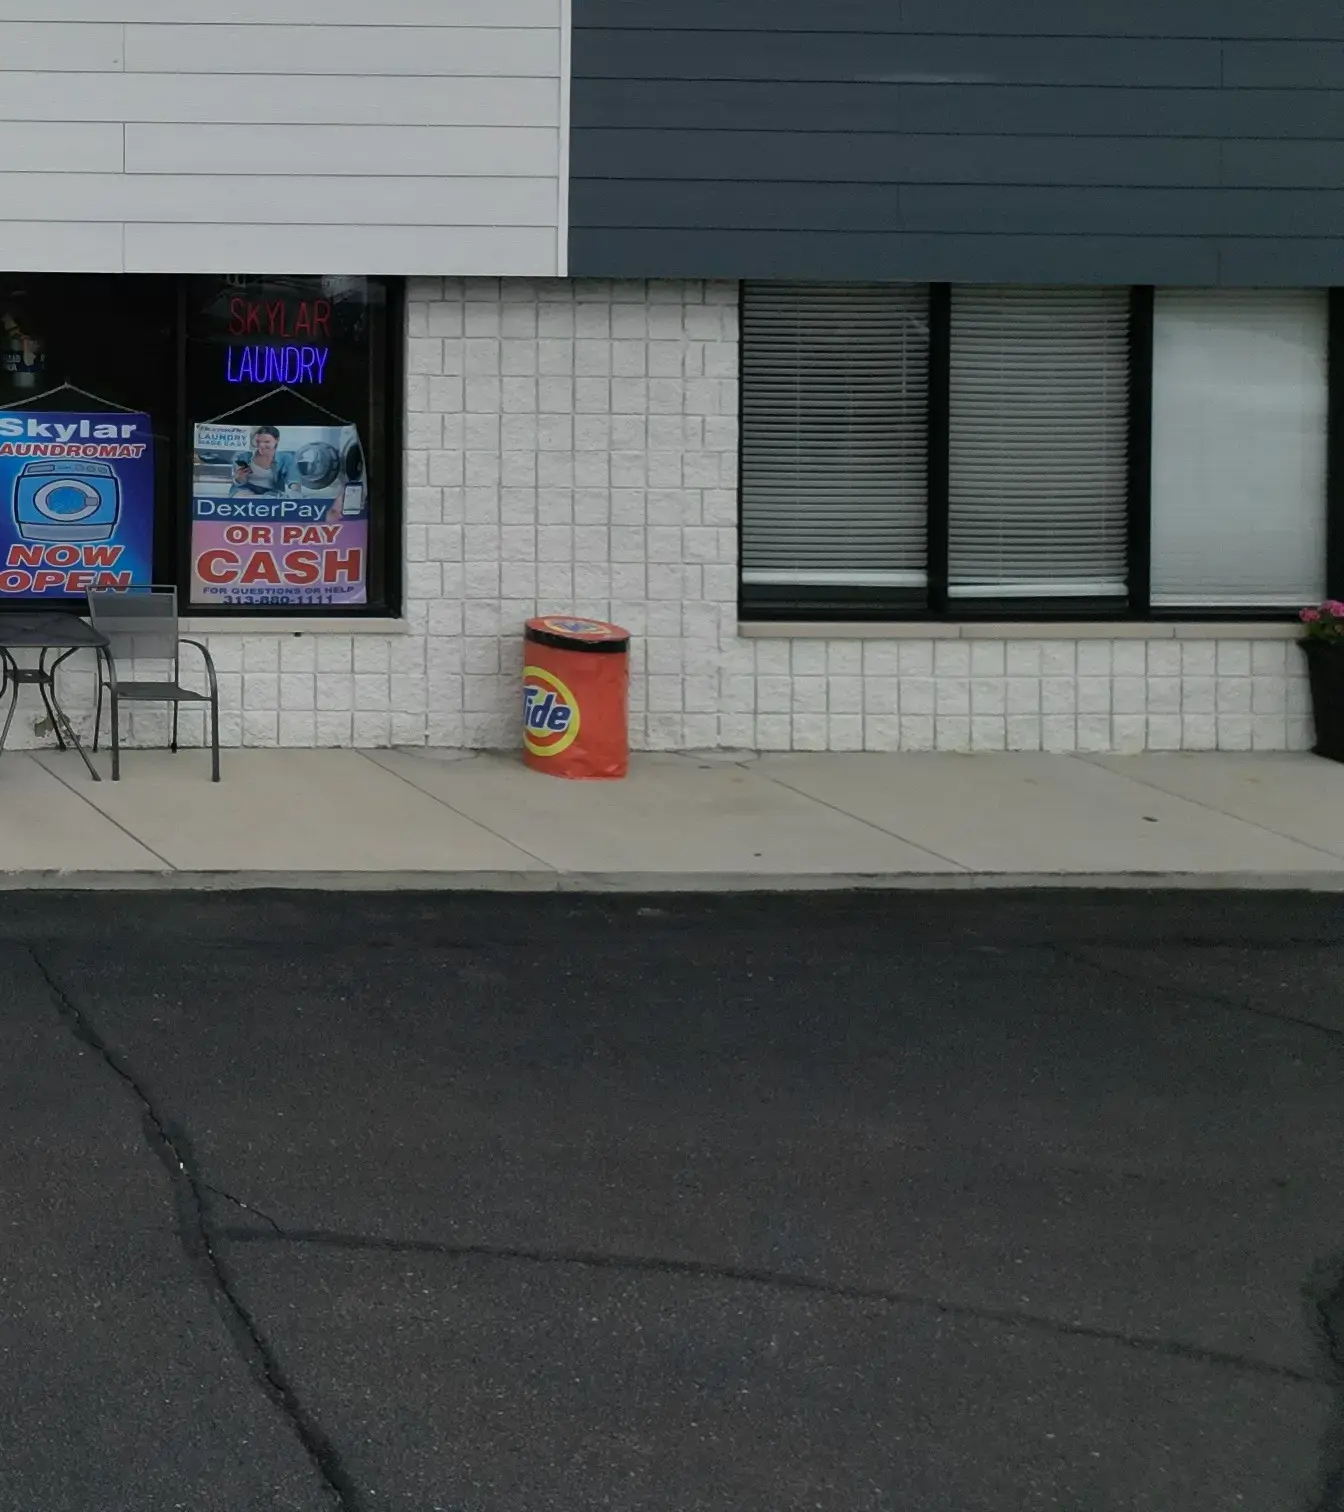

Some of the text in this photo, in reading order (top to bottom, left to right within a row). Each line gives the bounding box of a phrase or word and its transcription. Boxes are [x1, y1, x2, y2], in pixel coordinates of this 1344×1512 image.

[228, 297, 332, 338] SKYLAR
[227, 345, 329, 384] LAUNDRY
[197, 499, 326, 521] DexterPay
[224, 524, 342, 546] OR PAY
[6, 544, 124, 568] NOW
[196, 548, 362, 586] CASH
[203, 587, 227, 595] FOR
[231, 587, 301, 595] QUESTIONS
[324, 586, 354, 594] HELP
[524, 687, 571, 730] Tide
